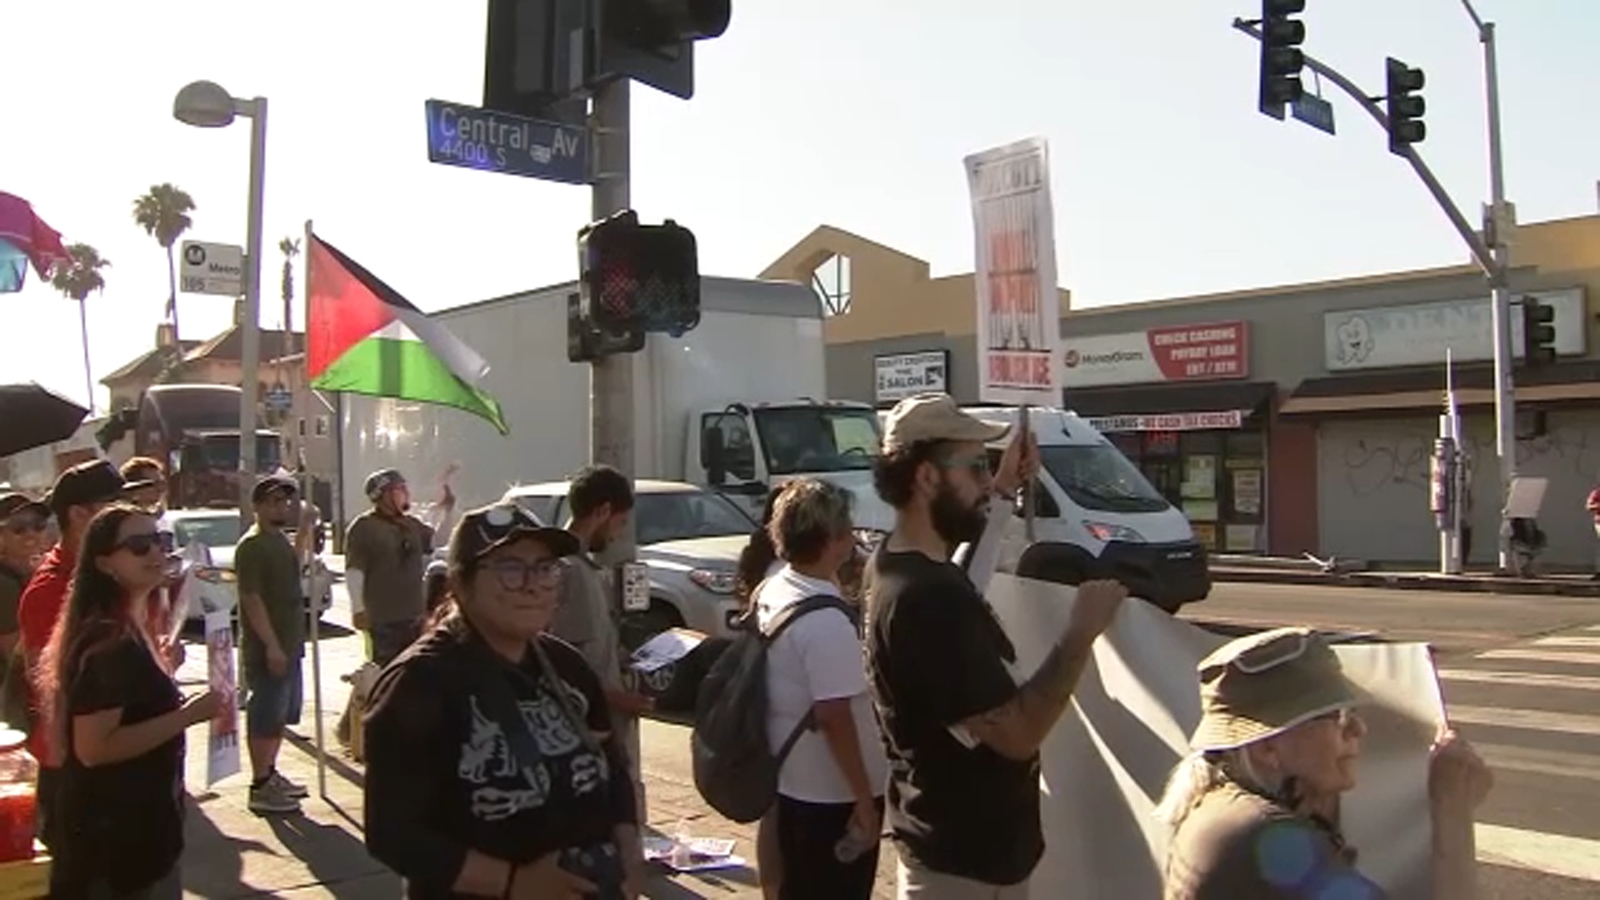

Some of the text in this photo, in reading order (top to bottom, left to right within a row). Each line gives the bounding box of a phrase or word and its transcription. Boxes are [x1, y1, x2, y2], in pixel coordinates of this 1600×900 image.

[439, 106, 579, 157] Central Av
[439, 139, 506, 168] 4400 S
[209, 262, 240, 275] Metro
[1154, 327, 1236, 346] CHECK CASHING
[1081, 350, 1144, 364] MoneyGram
[887, 376, 922, 388] SALON
